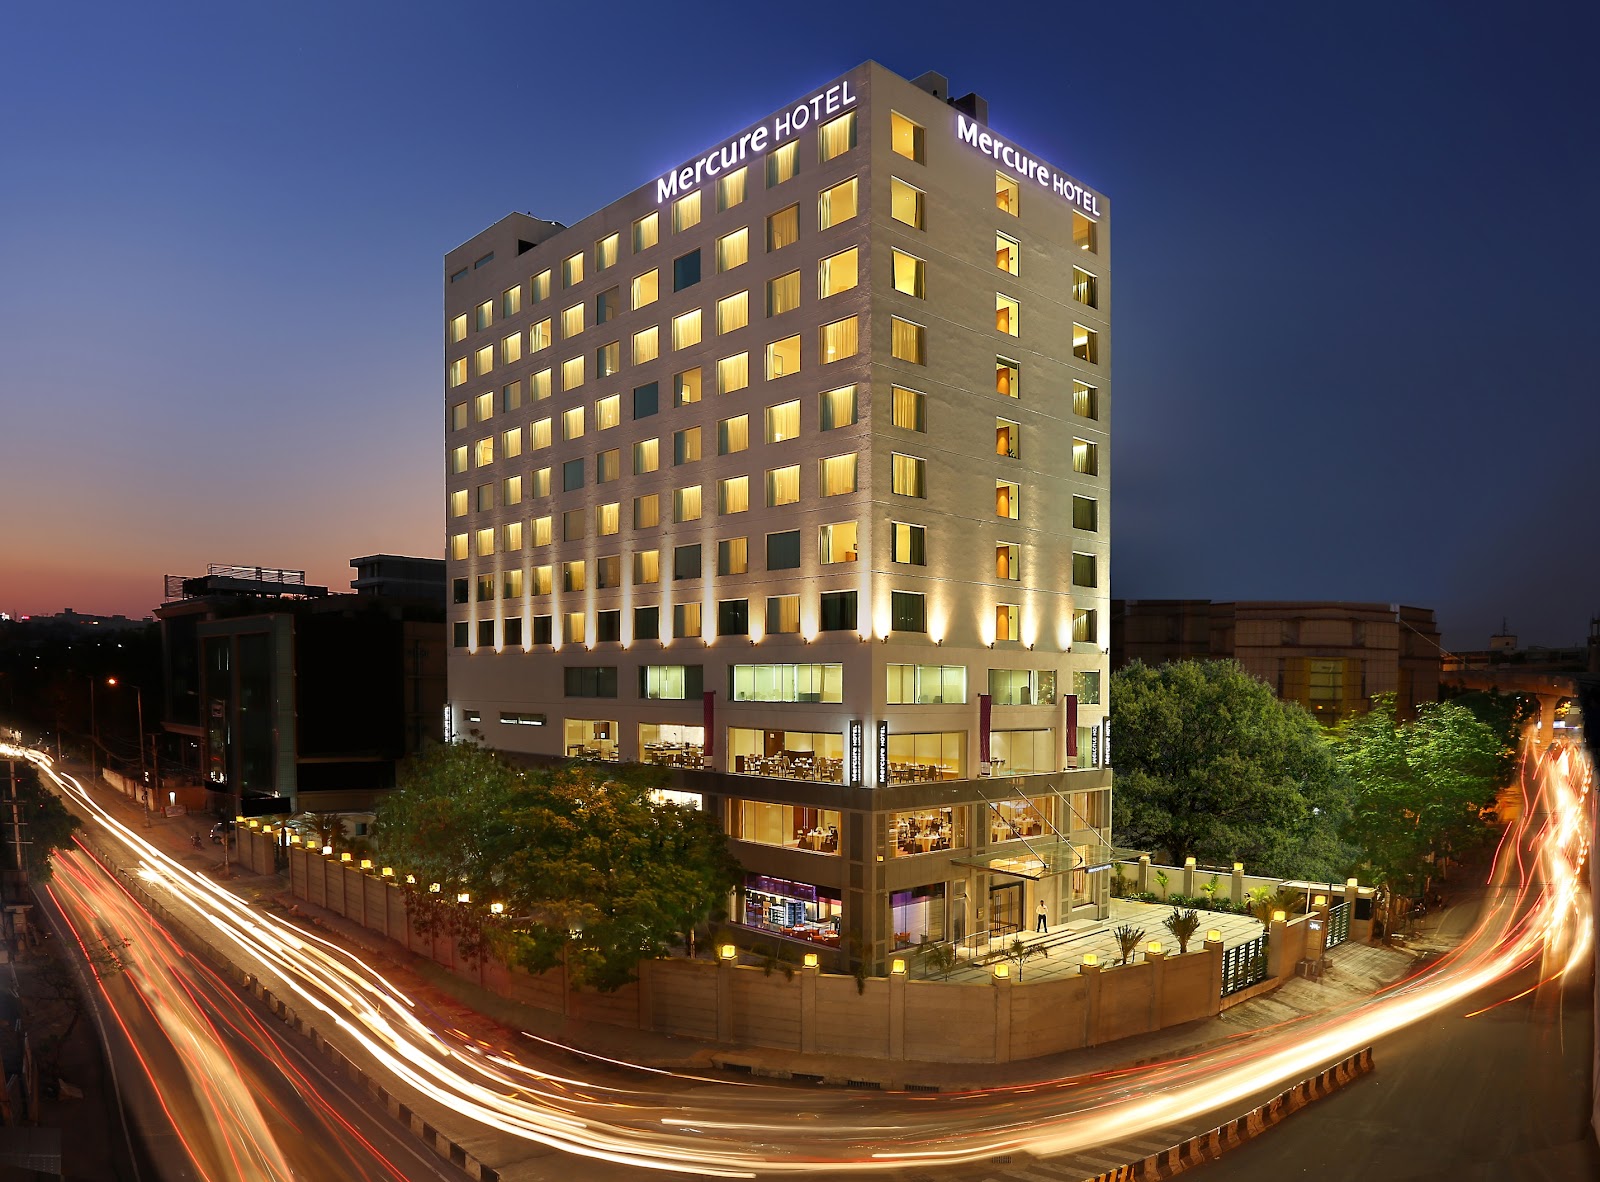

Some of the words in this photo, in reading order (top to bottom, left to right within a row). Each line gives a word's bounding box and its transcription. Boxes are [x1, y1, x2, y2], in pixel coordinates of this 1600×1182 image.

[657, 126, 768, 203] Mercure
[775, 81, 856, 141] HOTEL
[957, 115, 1049, 187] Mercure
[1053, 174, 1100, 216] HOTEL
